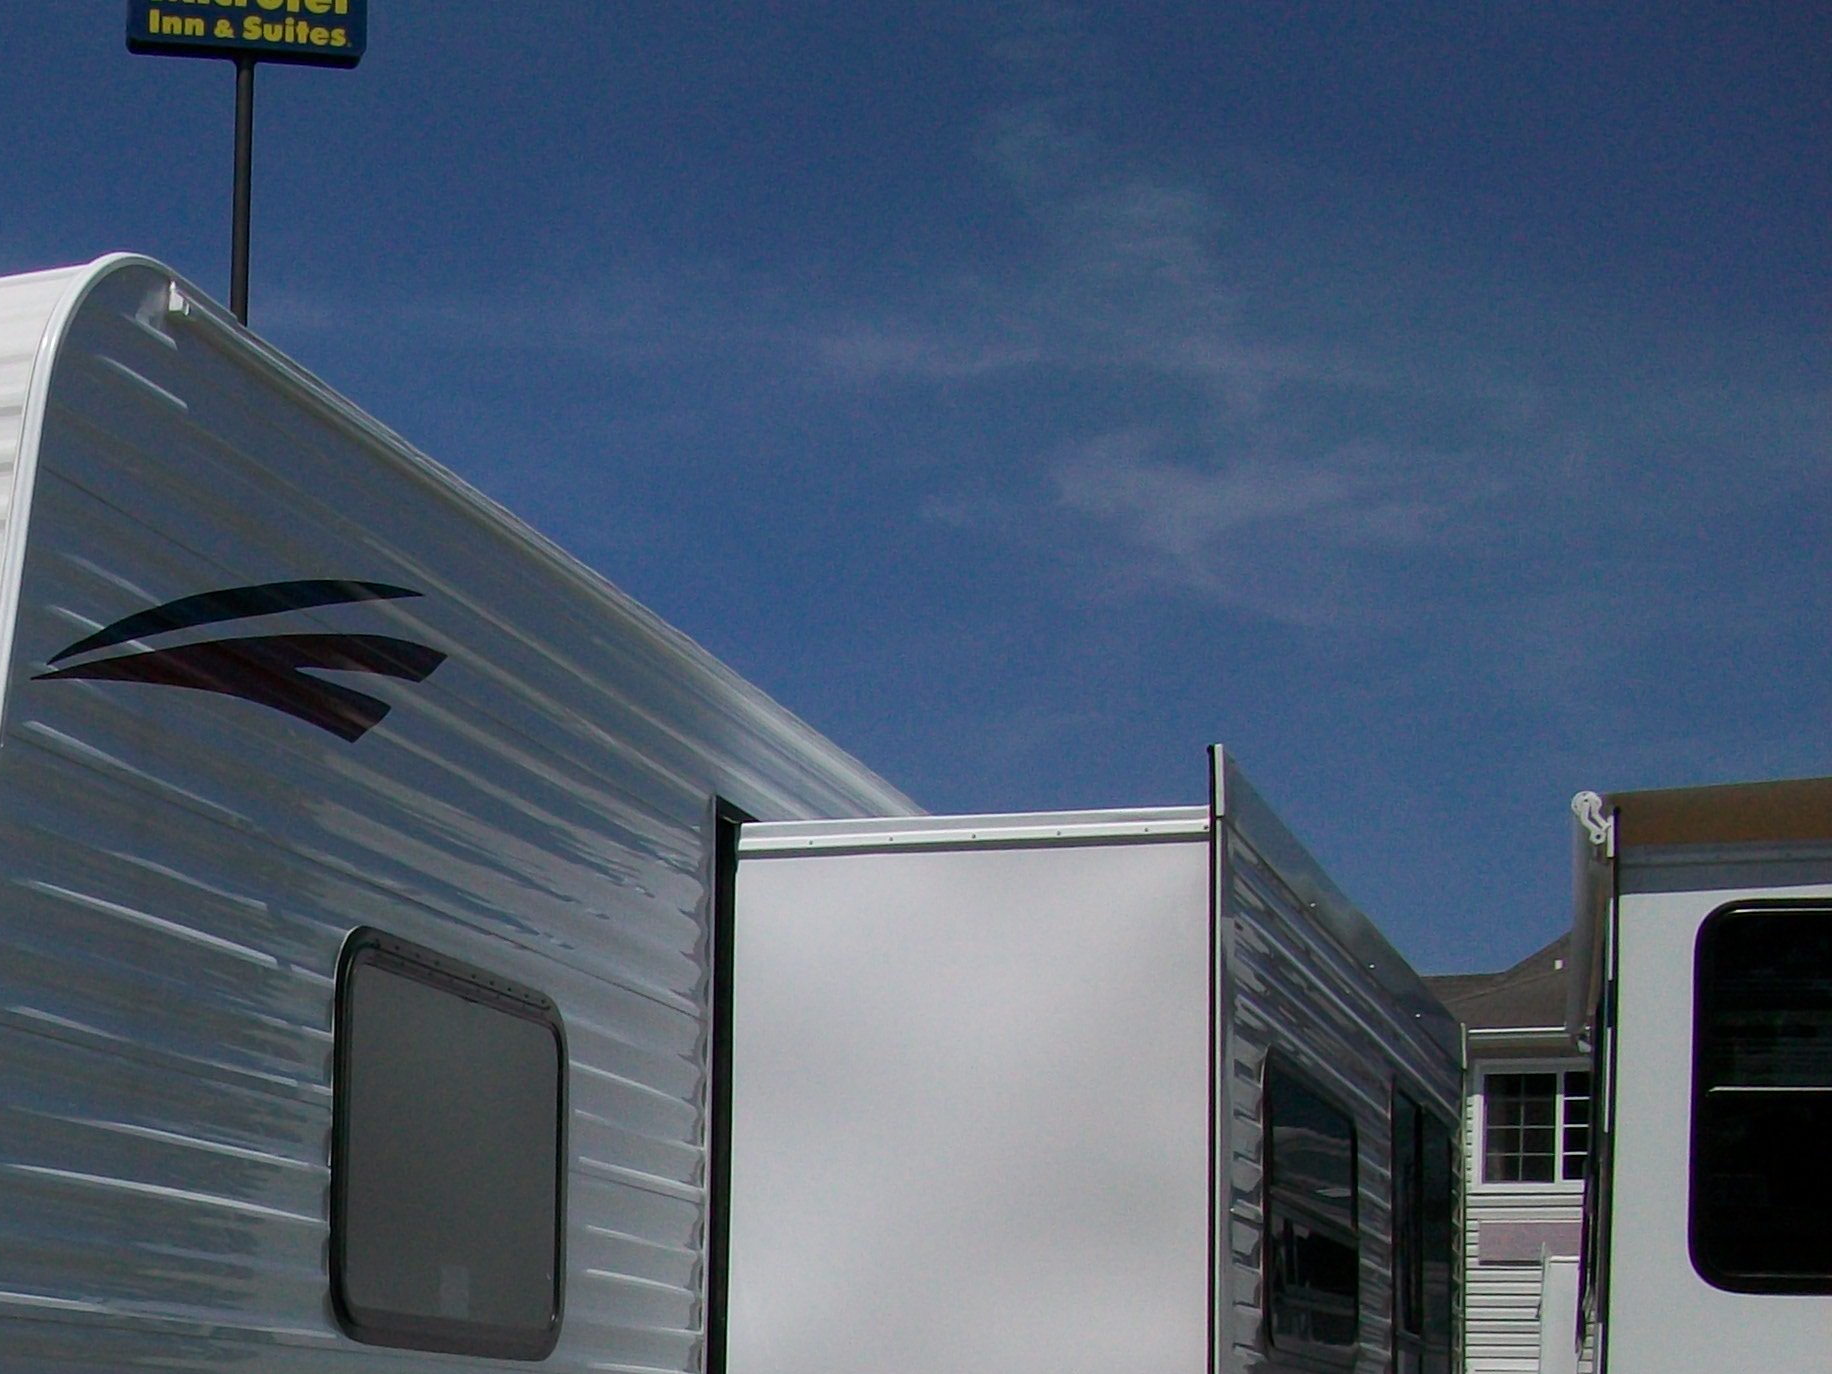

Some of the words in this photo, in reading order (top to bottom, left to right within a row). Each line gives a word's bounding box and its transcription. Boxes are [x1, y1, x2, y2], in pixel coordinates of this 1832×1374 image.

[148, 9, 204, 36] Inn
[214, 19, 234, 38] &
[242, 16, 347, 47] Suites
